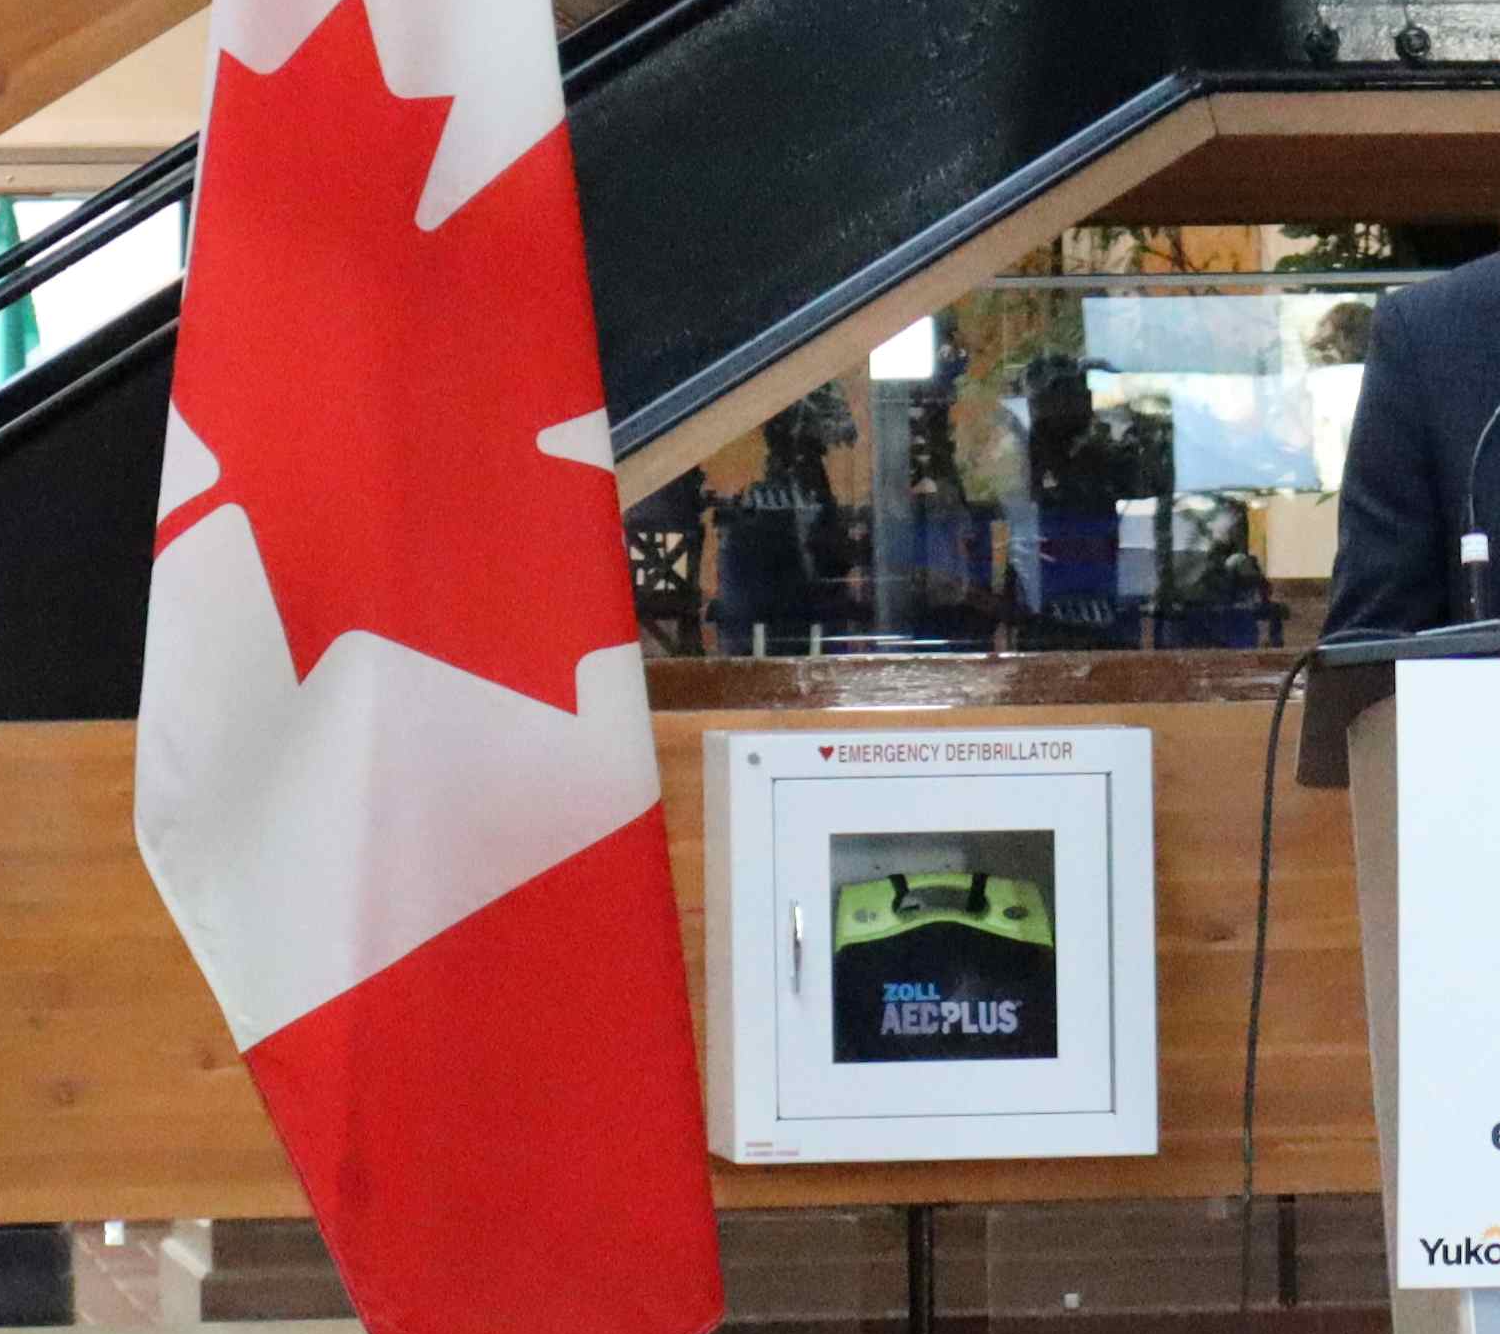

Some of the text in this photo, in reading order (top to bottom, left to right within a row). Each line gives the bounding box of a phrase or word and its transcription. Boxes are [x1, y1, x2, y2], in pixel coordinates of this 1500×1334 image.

[838, 741, 1073, 764] EMERGENCY DEFIBRILLATOR
[884, 982, 941, 1001] ZOLL
